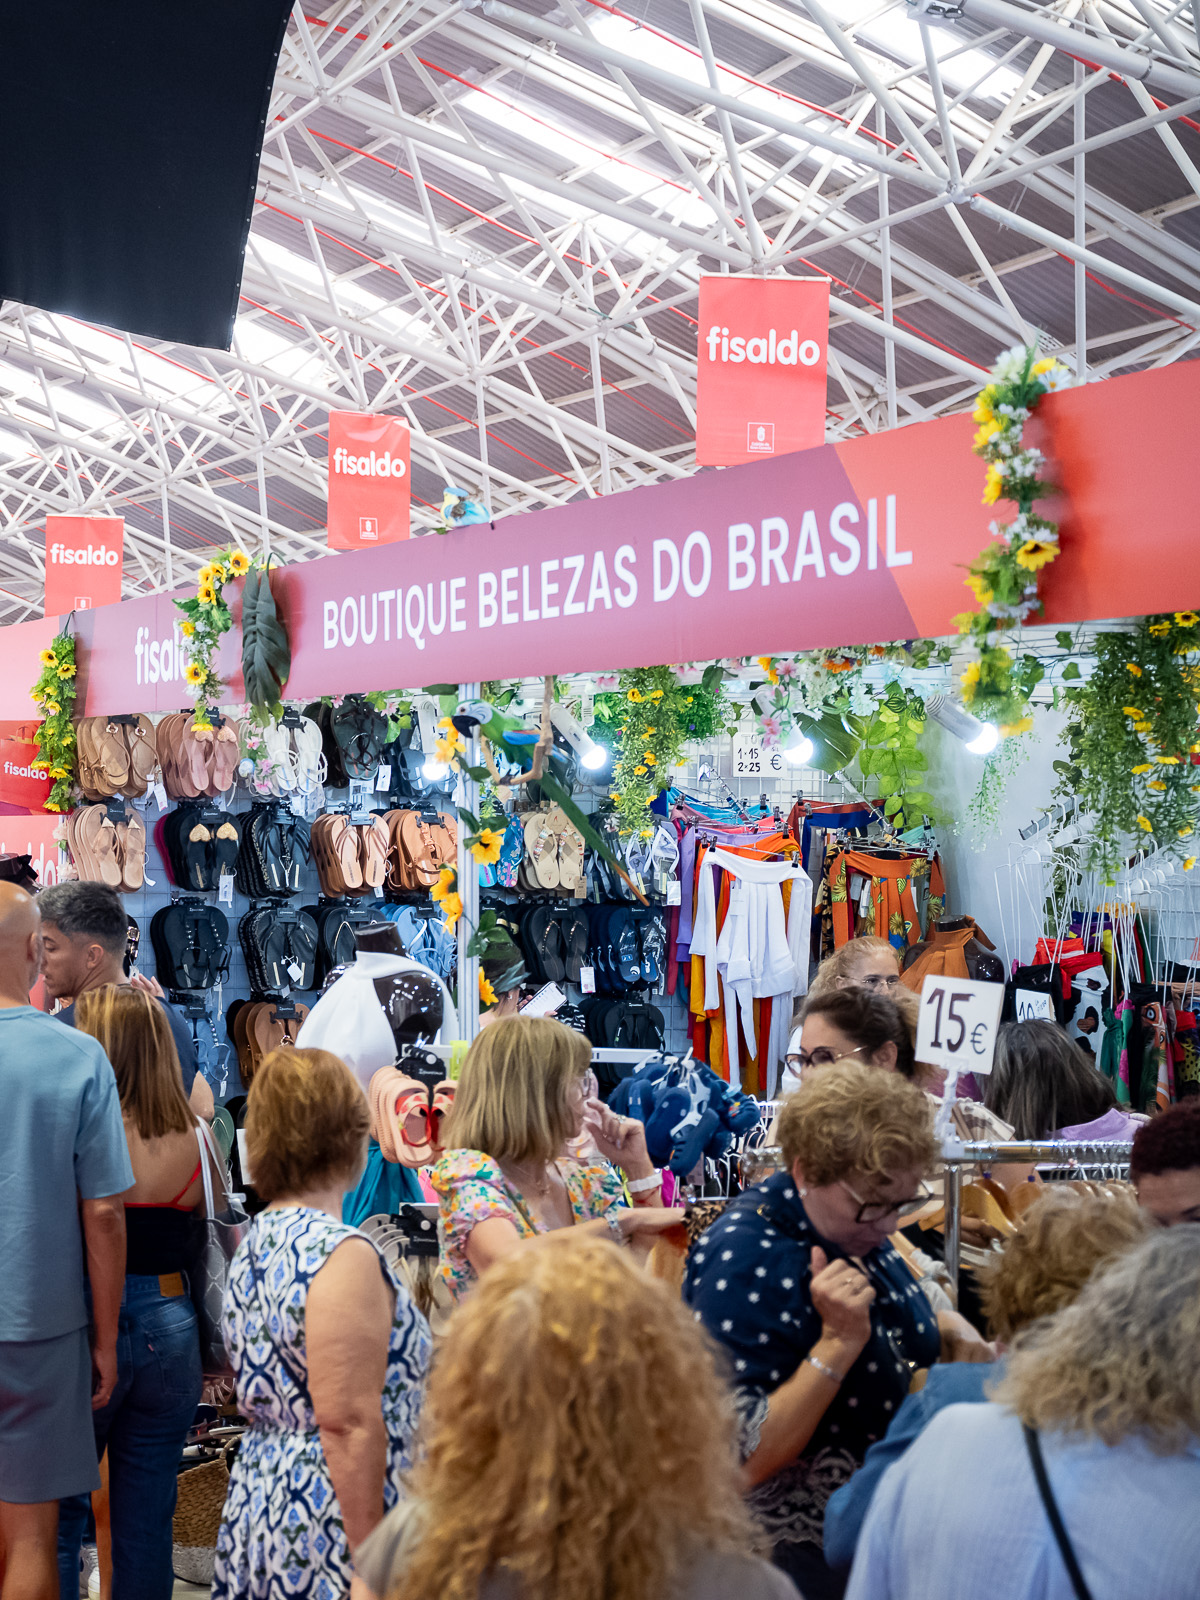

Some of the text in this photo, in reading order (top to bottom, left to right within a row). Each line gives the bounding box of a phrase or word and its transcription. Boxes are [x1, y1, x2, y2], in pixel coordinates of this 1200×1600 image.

[706, 325, 820, 366] fisaldo
[333, 447, 406, 478] fisaldo
[50, 543, 119, 566] fisaldo
[323, 494, 913, 650] BOUTIQUE BELEZAS DO BRASIL
[135, 619, 193, 685] fisal
[3, 761, 47, 780] fisaldo
[926, 987, 988, 1055] 15 €
